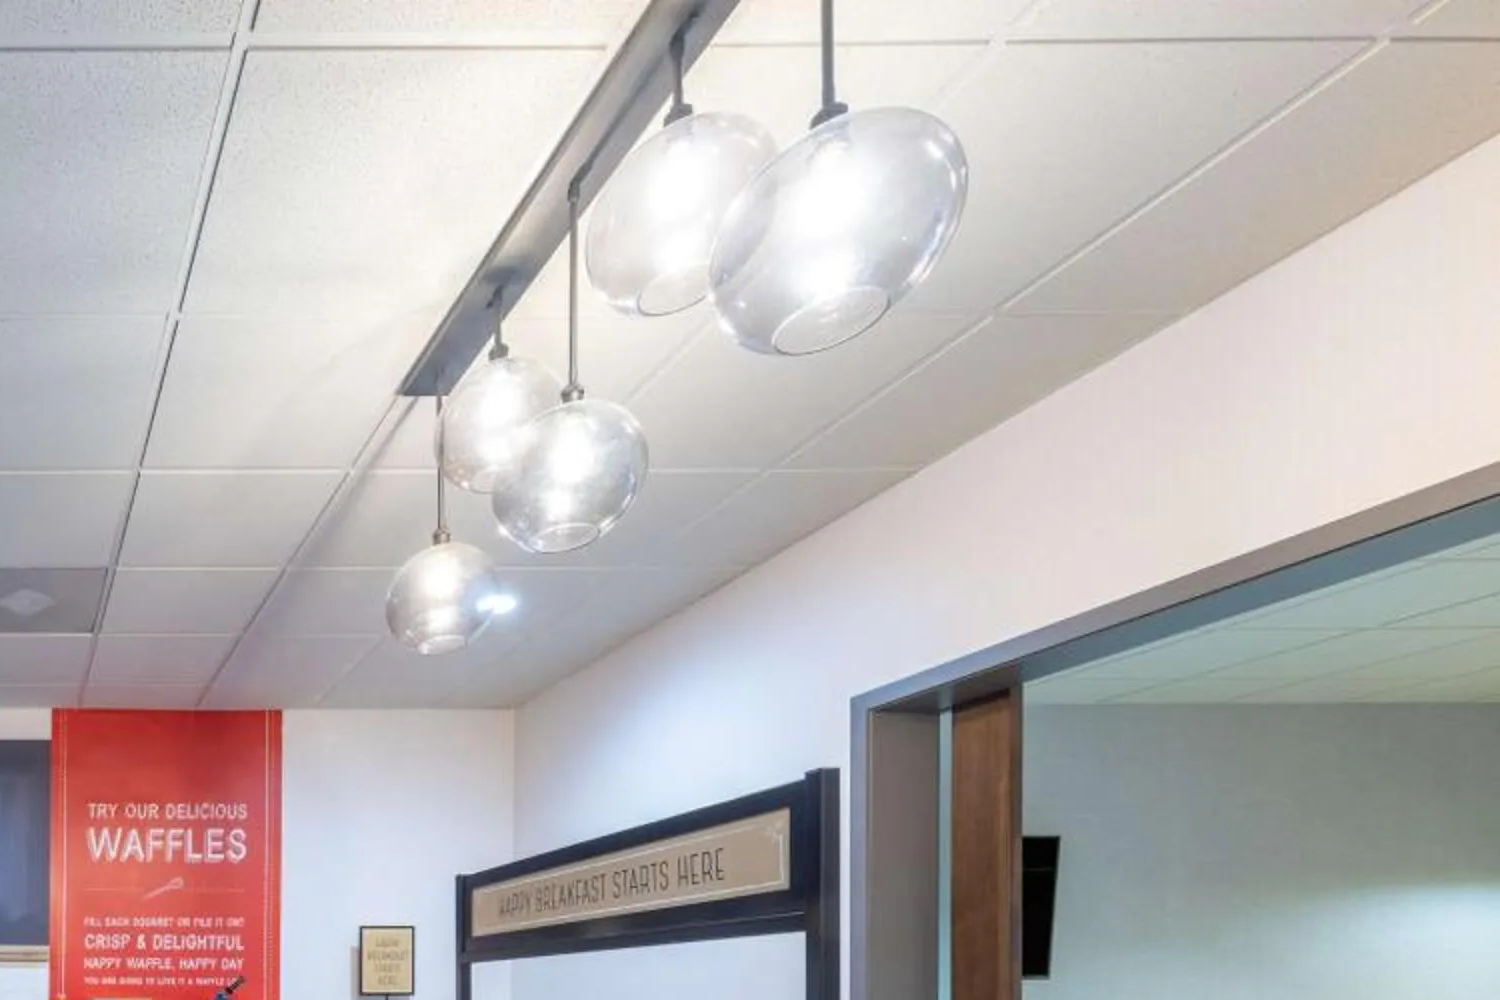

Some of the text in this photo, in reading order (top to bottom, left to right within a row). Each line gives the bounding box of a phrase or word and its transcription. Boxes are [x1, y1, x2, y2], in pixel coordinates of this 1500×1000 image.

[87, 803, 248, 819] TRY OUR DELICIOUS
[86, 827, 248, 864] WAFFLES
[535, 873, 607, 912] BREAKFAST
[612, 861, 670, 899] STARTS
[677, 847, 725, 886] HERE
[84, 933, 244, 951] CRISP & DELIGHTFUL
[83, 957, 122, 969] HAPPY
[180, 957, 218, 970] HAPPY
[221, 957, 244, 970] DAY
